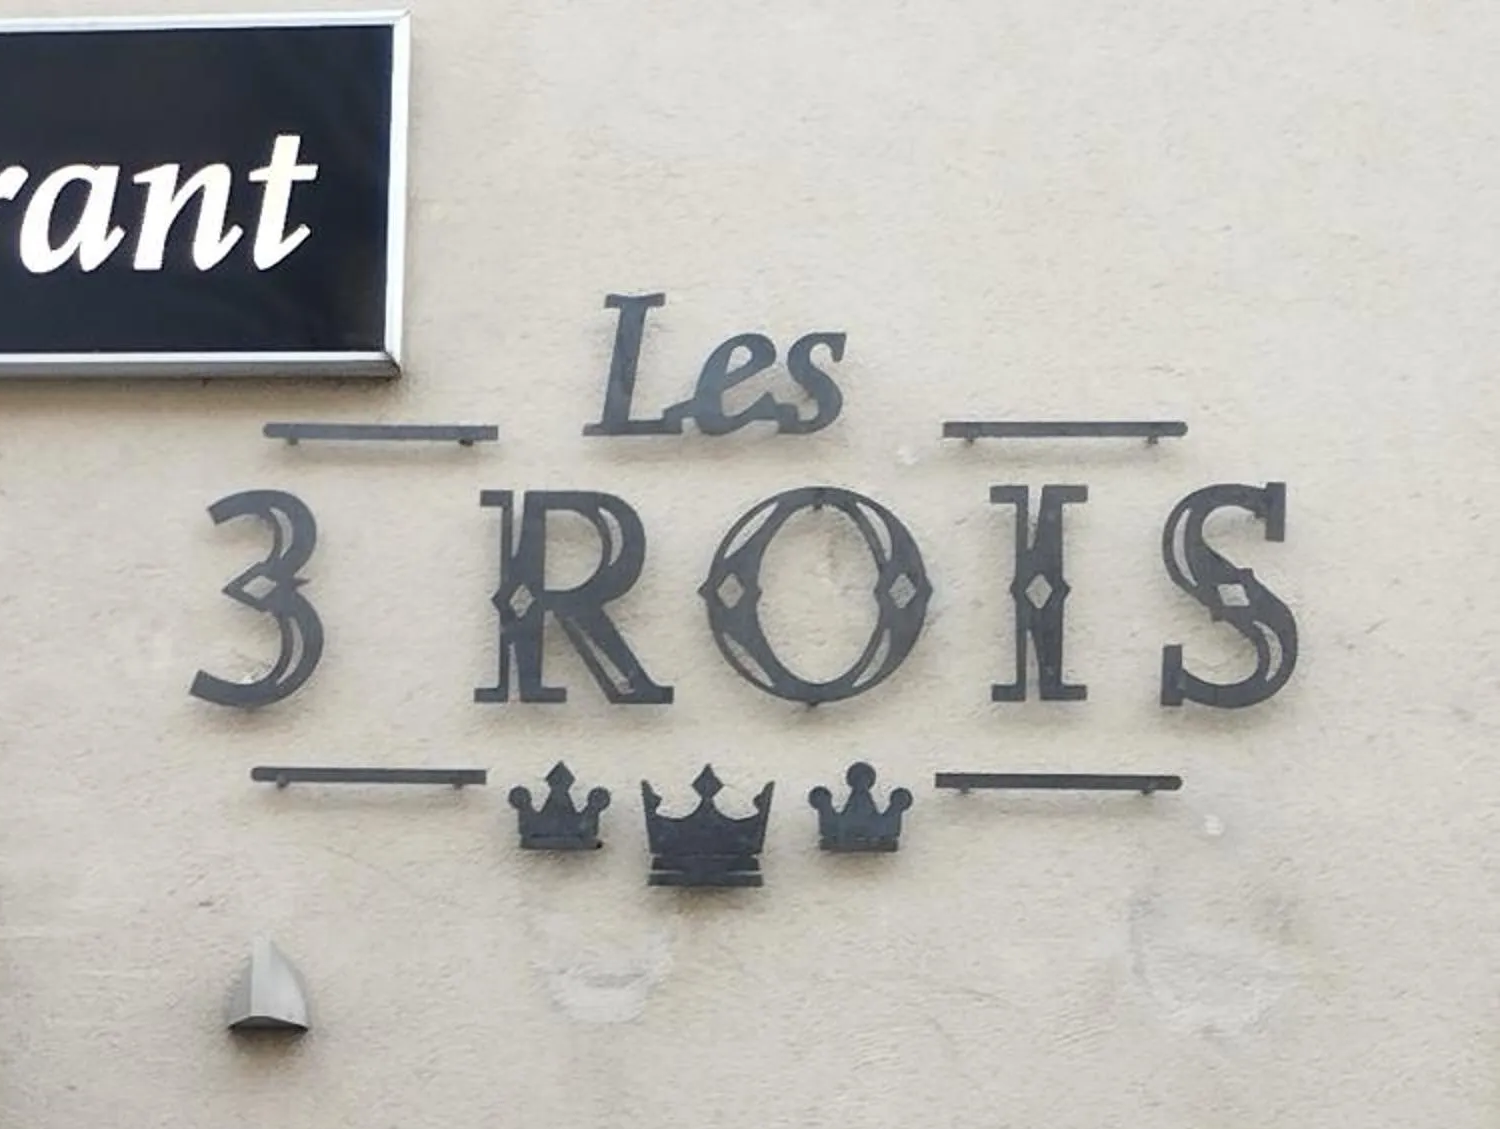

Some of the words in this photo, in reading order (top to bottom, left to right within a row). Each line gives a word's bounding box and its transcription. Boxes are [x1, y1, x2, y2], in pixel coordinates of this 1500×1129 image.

[583, 293, 847, 437] Les
[189, 490, 324, 708] 3
[473, 482, 1299, 710] ROIS
